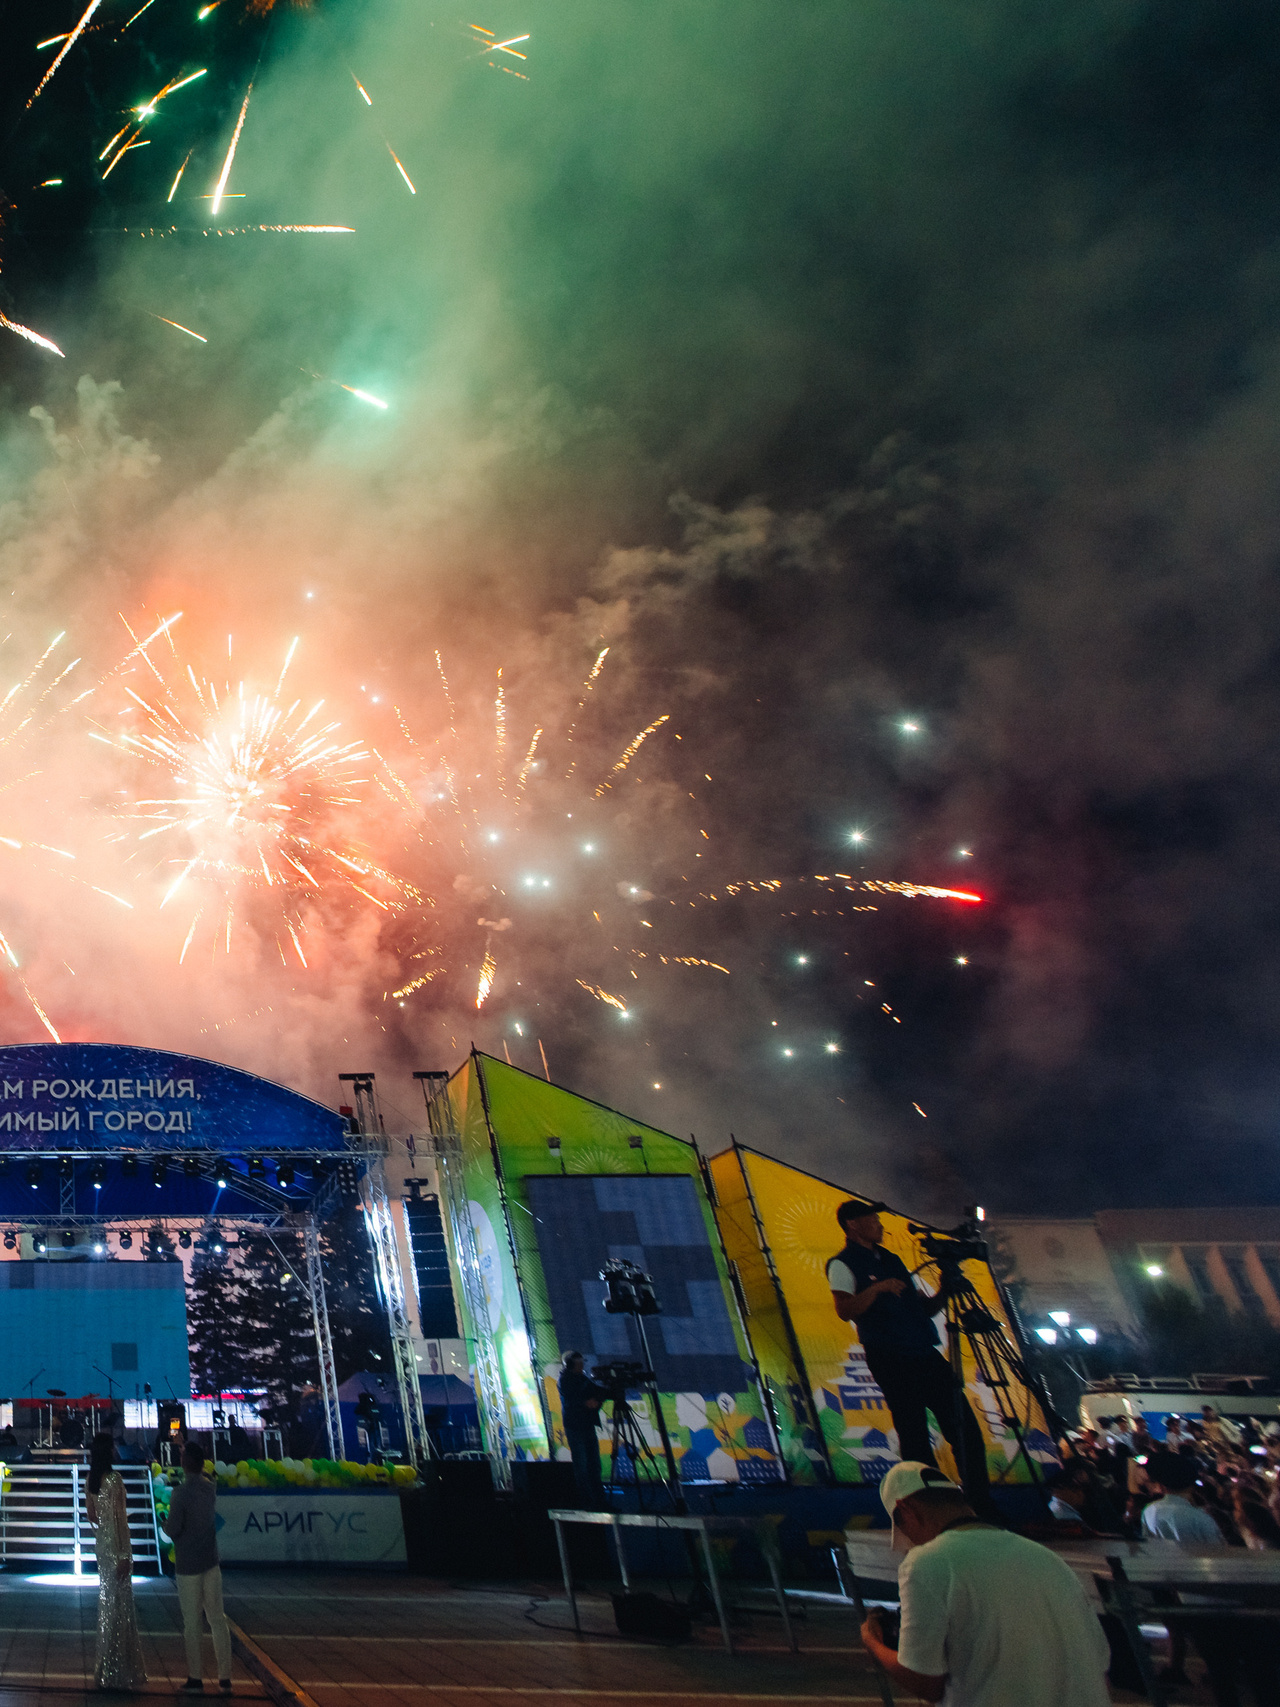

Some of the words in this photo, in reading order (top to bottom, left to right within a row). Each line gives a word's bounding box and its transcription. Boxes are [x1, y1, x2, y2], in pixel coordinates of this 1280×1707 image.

[32, 1079, 202, 1101] РОЖДЕНИЯ,
[88, 1110, 192, 1134] ГОРОД!
[243, 1511, 367, 1534] АРИГУС
